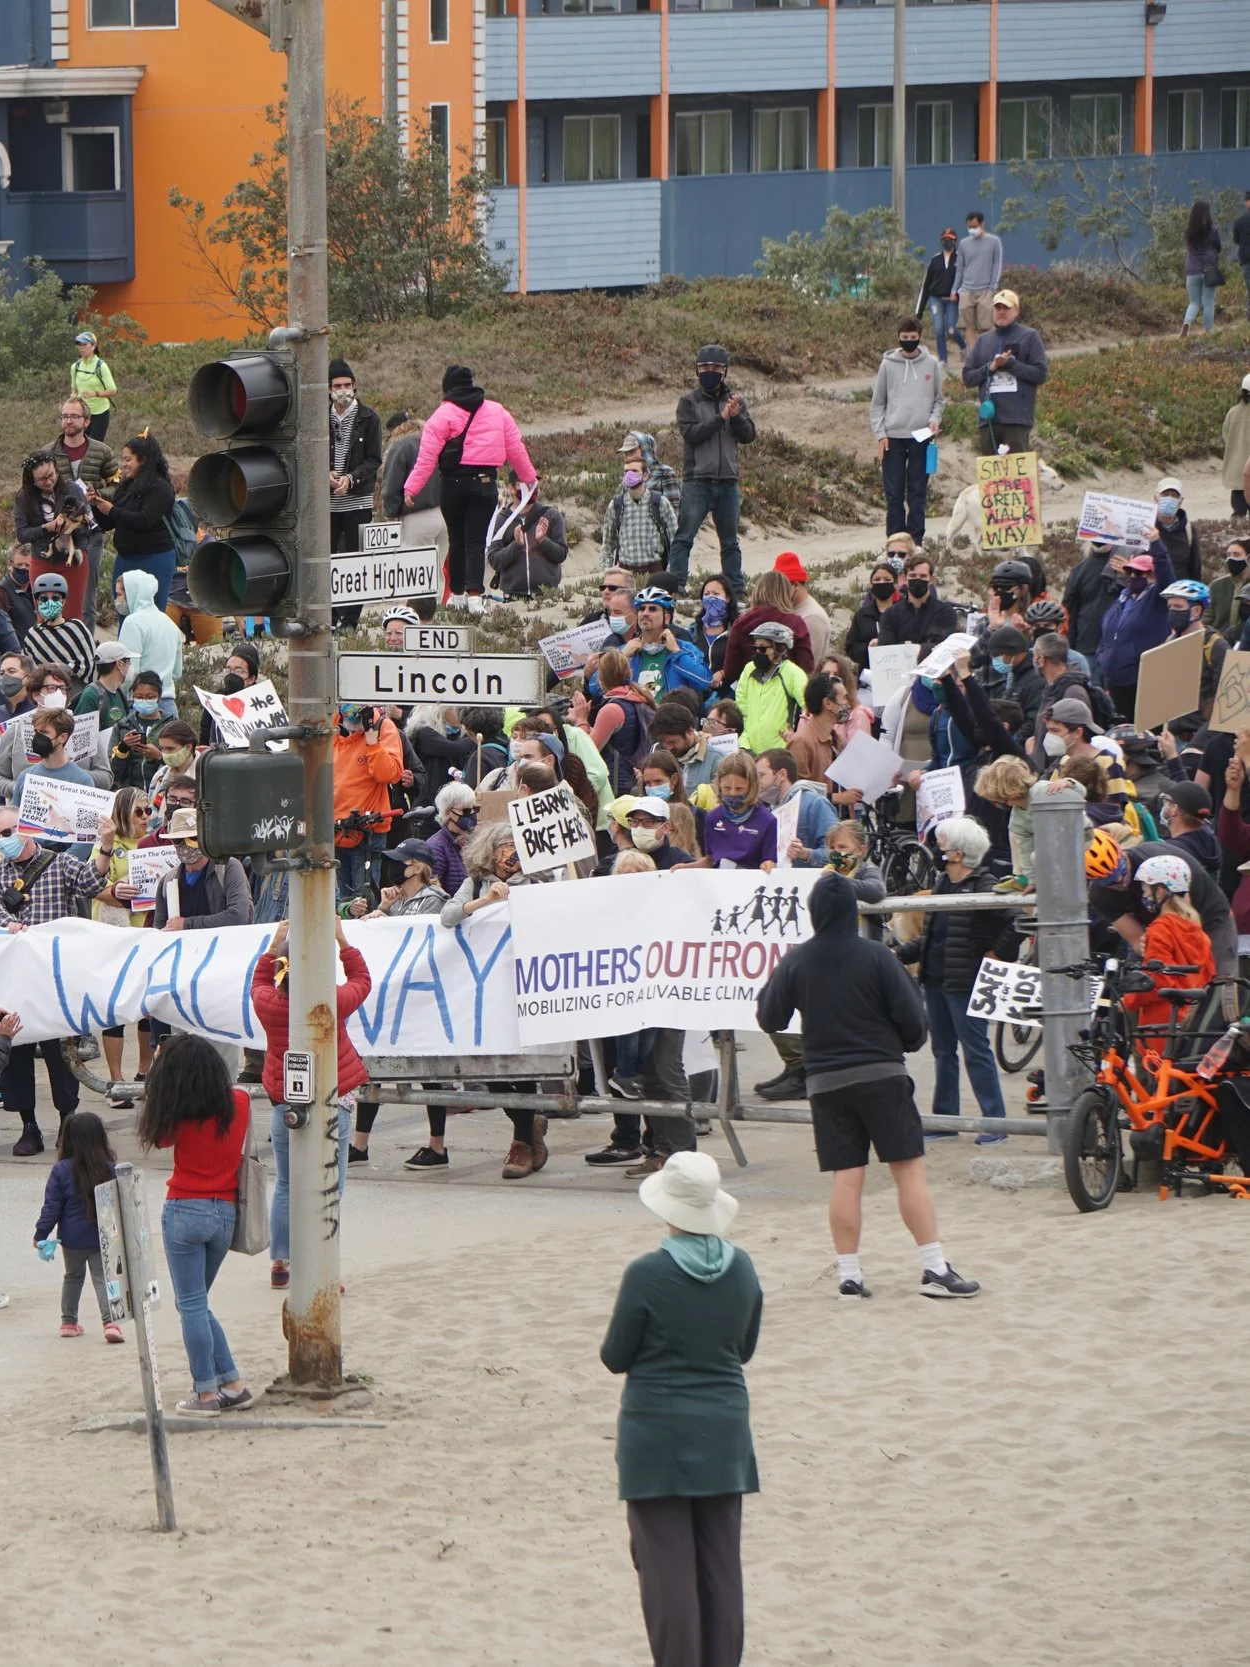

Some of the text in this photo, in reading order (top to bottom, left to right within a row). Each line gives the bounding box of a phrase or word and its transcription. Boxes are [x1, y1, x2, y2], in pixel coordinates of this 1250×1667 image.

[993, 479, 1023, 493] THE
[981, 491, 1030, 508] GREAT
[986, 506, 1035, 526] WALK
[367, 528, 389, 548] 1200
[986, 525, 1028, 546] WAY
[331, 557, 435, 597] Great Highway
[419, 631, 460, 649] END
[543, 623, 605, 647] Save The Great Walkway
[374, 665, 503, 695] Lincoln
[250, 694, 276, 712] the
[74, 715, 95, 724] alkway
[926, 771, 955, 781] Walkway
[29, 778, 45, 787] Save
[46, 781, 59, 790] The
[59, 784, 79, 795] Great
[80, 788, 111, 802] Walkway
[21, 813, 48, 824] PEOPLE
[23, 804, 49, 814] HIGHWAY
[512, 803, 525, 827] I
[522, 824, 559, 858] BIKE
[160, 849, 176, 857] Grea
[515, 940, 803, 996] MOTHERS OUT FRON
[52, 923, 512, 1048] WALWAY
[971, 962, 1008, 1016] SAFE
[1005, 969, 1040, 1020] KIDS
[517, 984, 758, 1018] MOBILIZING FOR A LIVABLE CLIM
